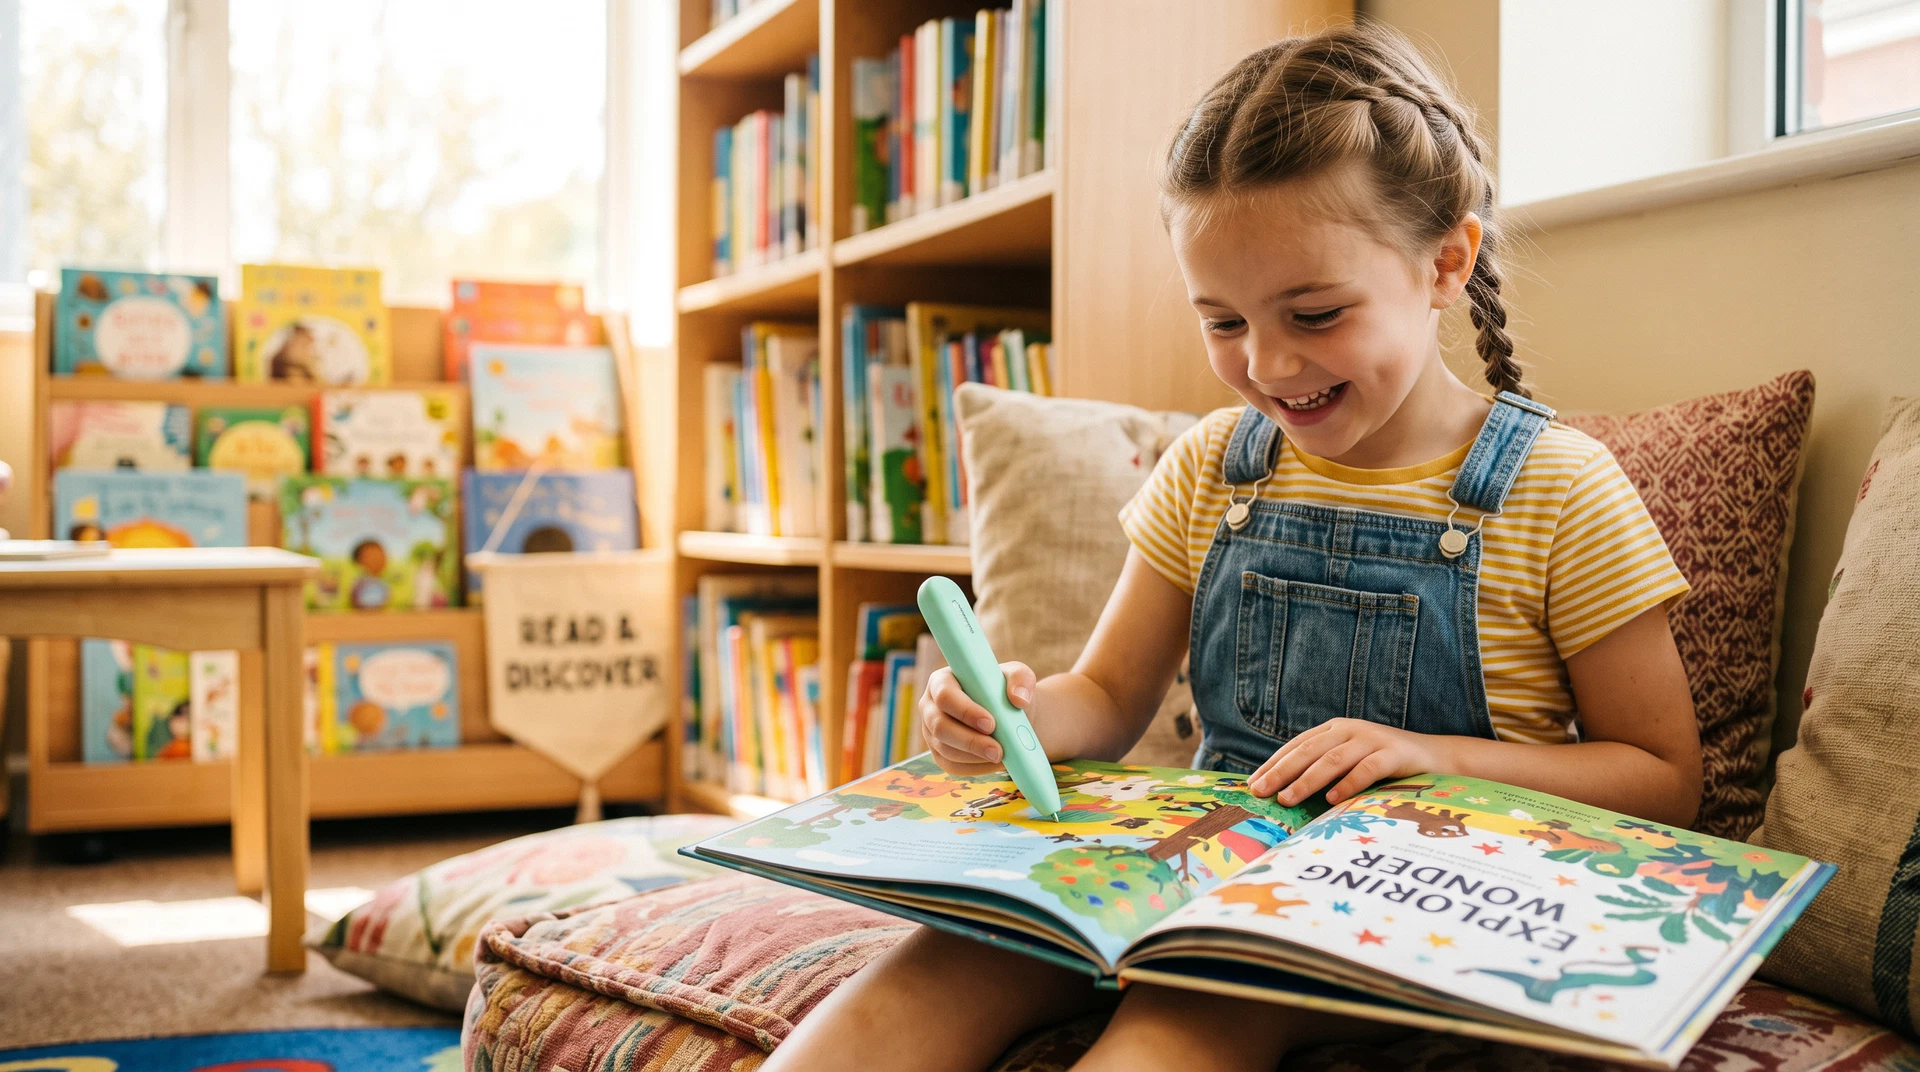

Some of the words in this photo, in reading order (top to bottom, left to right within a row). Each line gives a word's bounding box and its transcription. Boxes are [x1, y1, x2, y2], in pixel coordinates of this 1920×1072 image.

[520, 614, 604, 644] READ
[617, 613, 637, 642] &
[507, 655, 660, 691] DISCOVER
[1298, 865, 1577, 952] EXPLORING
[1350, 850, 1565, 922] WONDER
